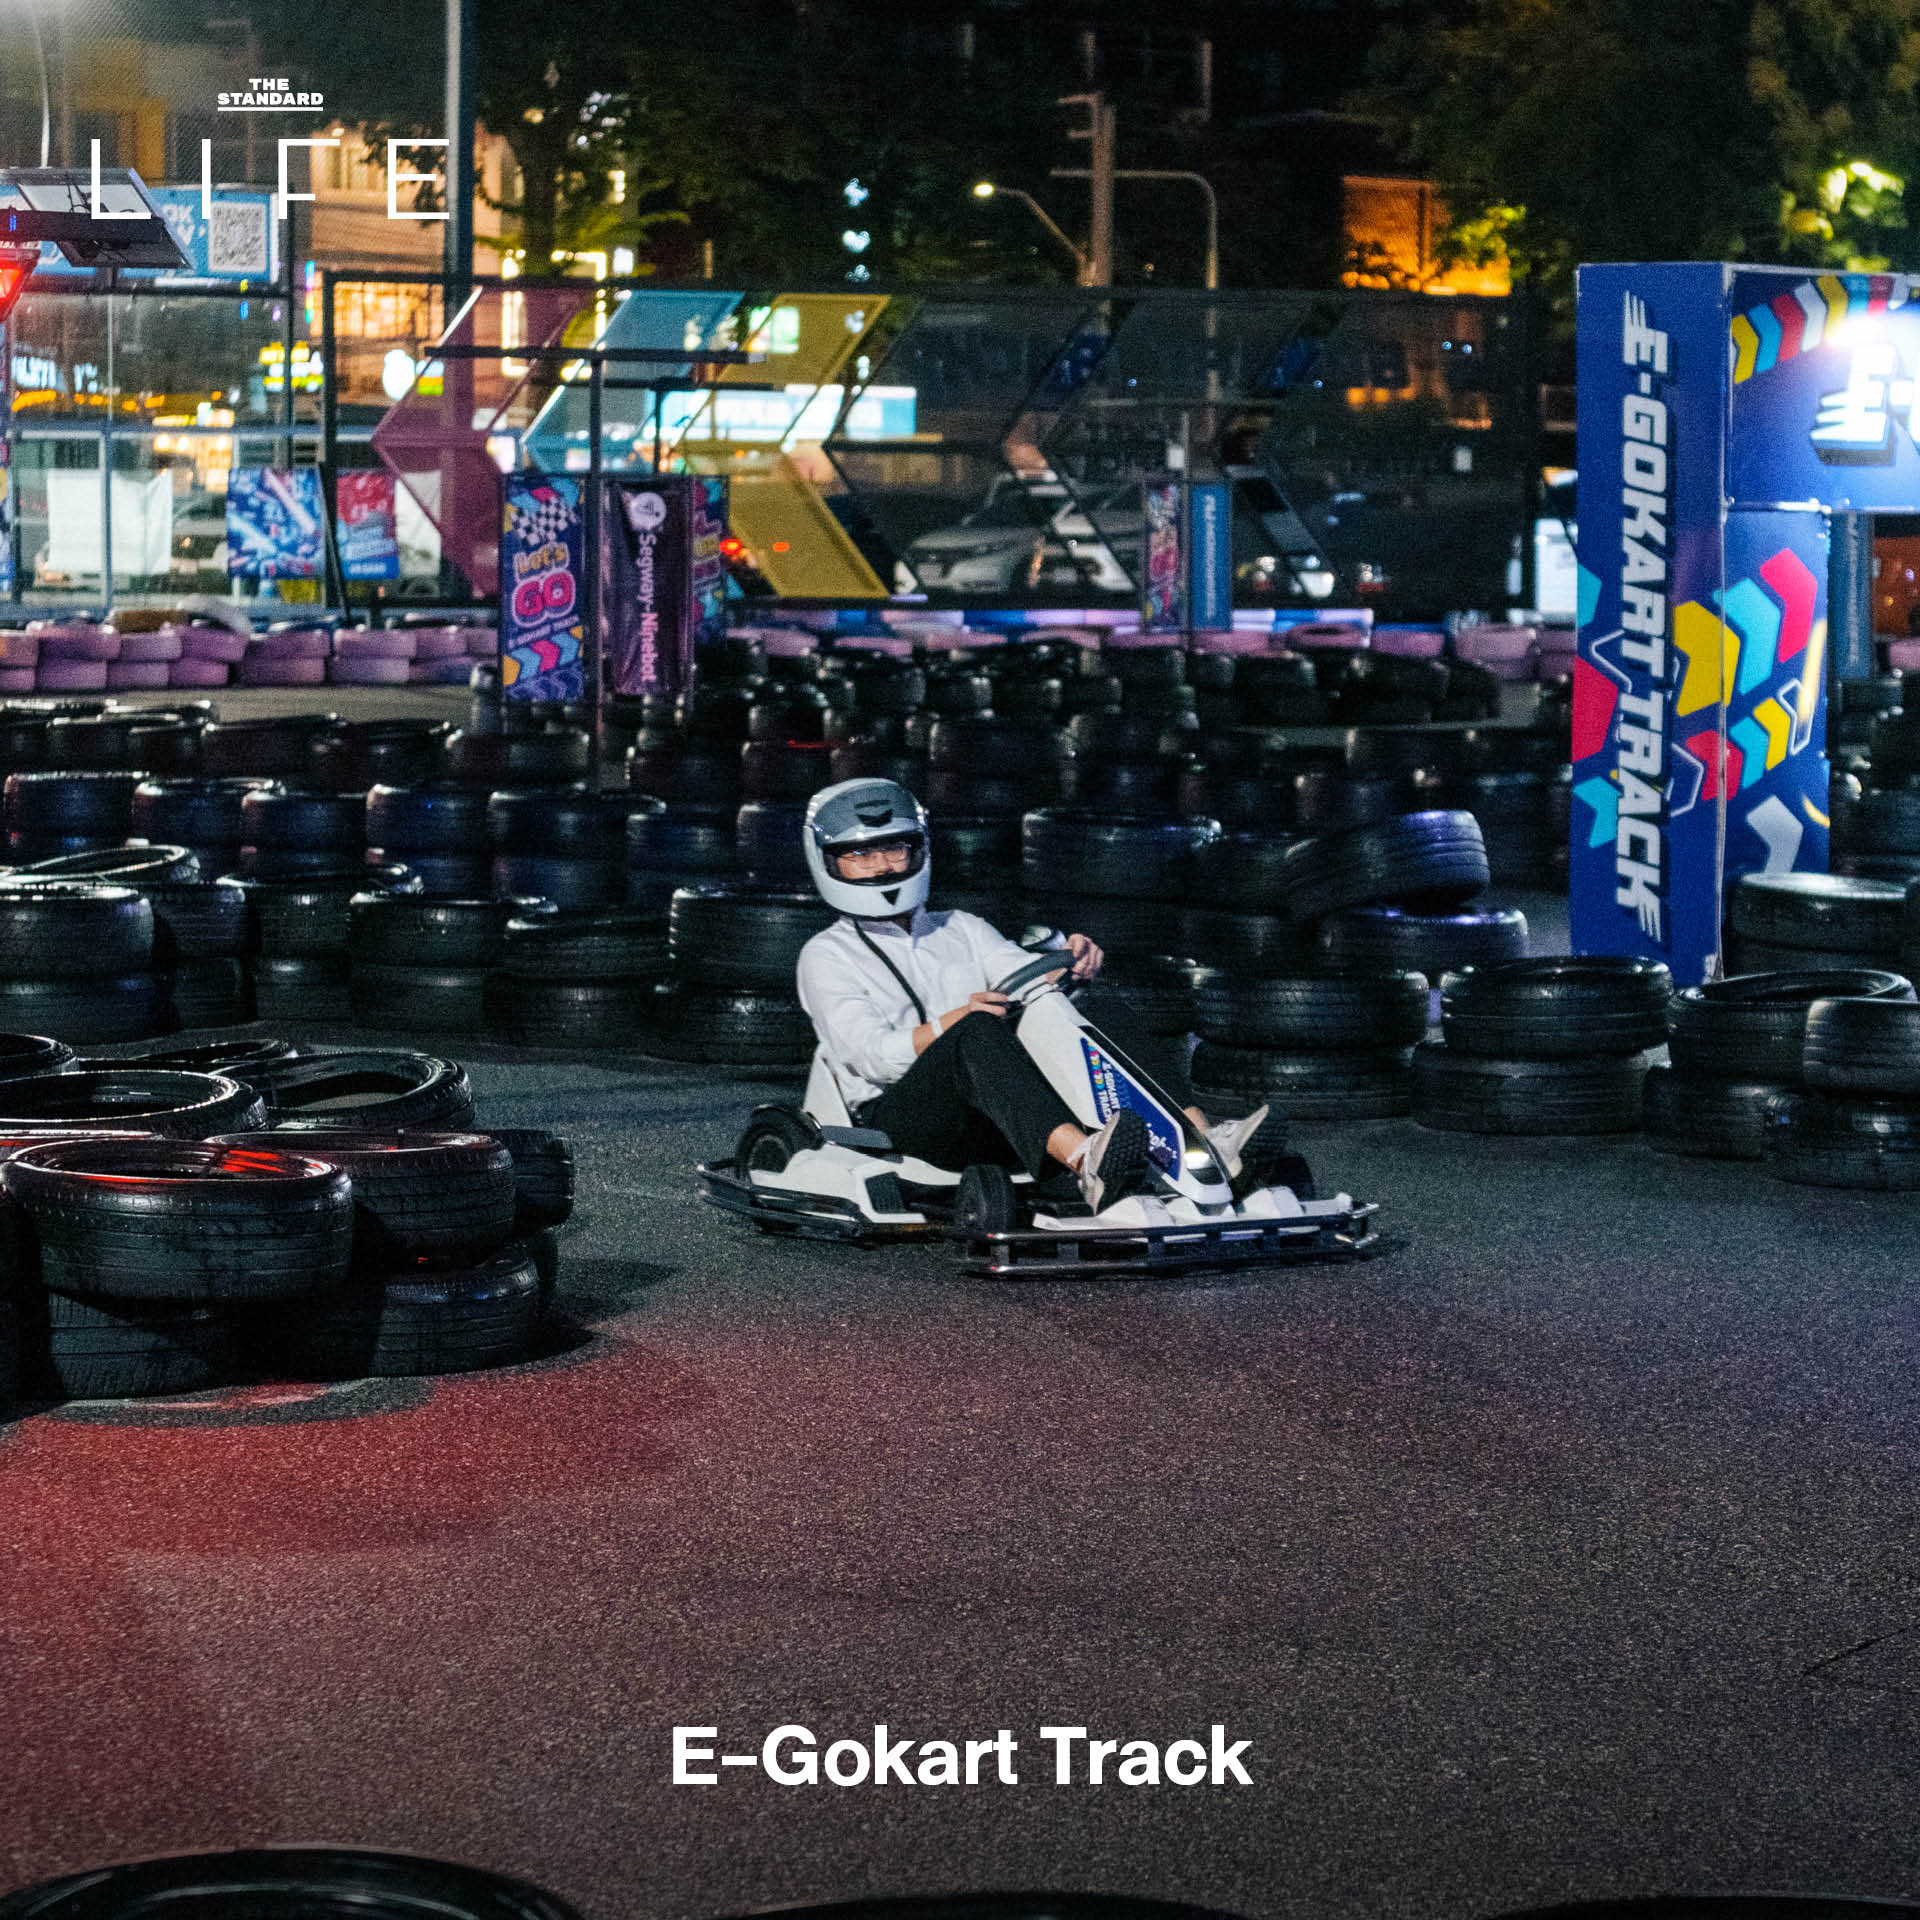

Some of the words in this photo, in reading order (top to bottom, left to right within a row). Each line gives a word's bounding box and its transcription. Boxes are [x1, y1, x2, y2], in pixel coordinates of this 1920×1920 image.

[1622, 290, 1668, 679] E-GOKART
[512, 569, 576, 625] GO
[514, 543, 570, 577] Let's
[636, 533, 659, 682] Segway-Ninebot
[1615, 690, 1664, 943] TRACK
